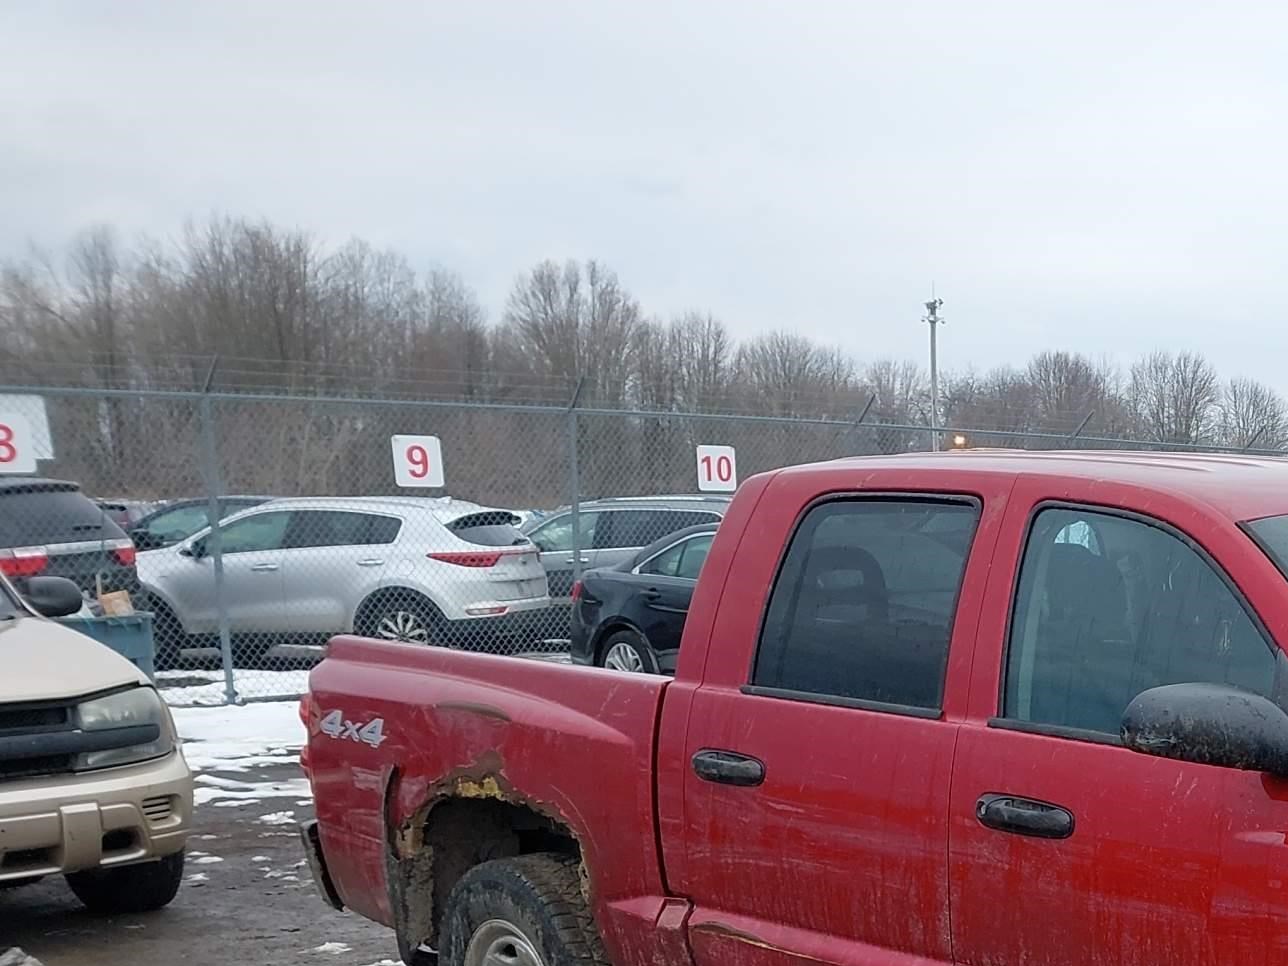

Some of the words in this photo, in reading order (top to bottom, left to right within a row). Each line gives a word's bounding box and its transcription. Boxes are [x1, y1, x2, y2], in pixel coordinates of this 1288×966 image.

[406, 445, 429, 478] 9
[701, 455, 732, 482] 10
[320, 709, 388, 749] 4x4
